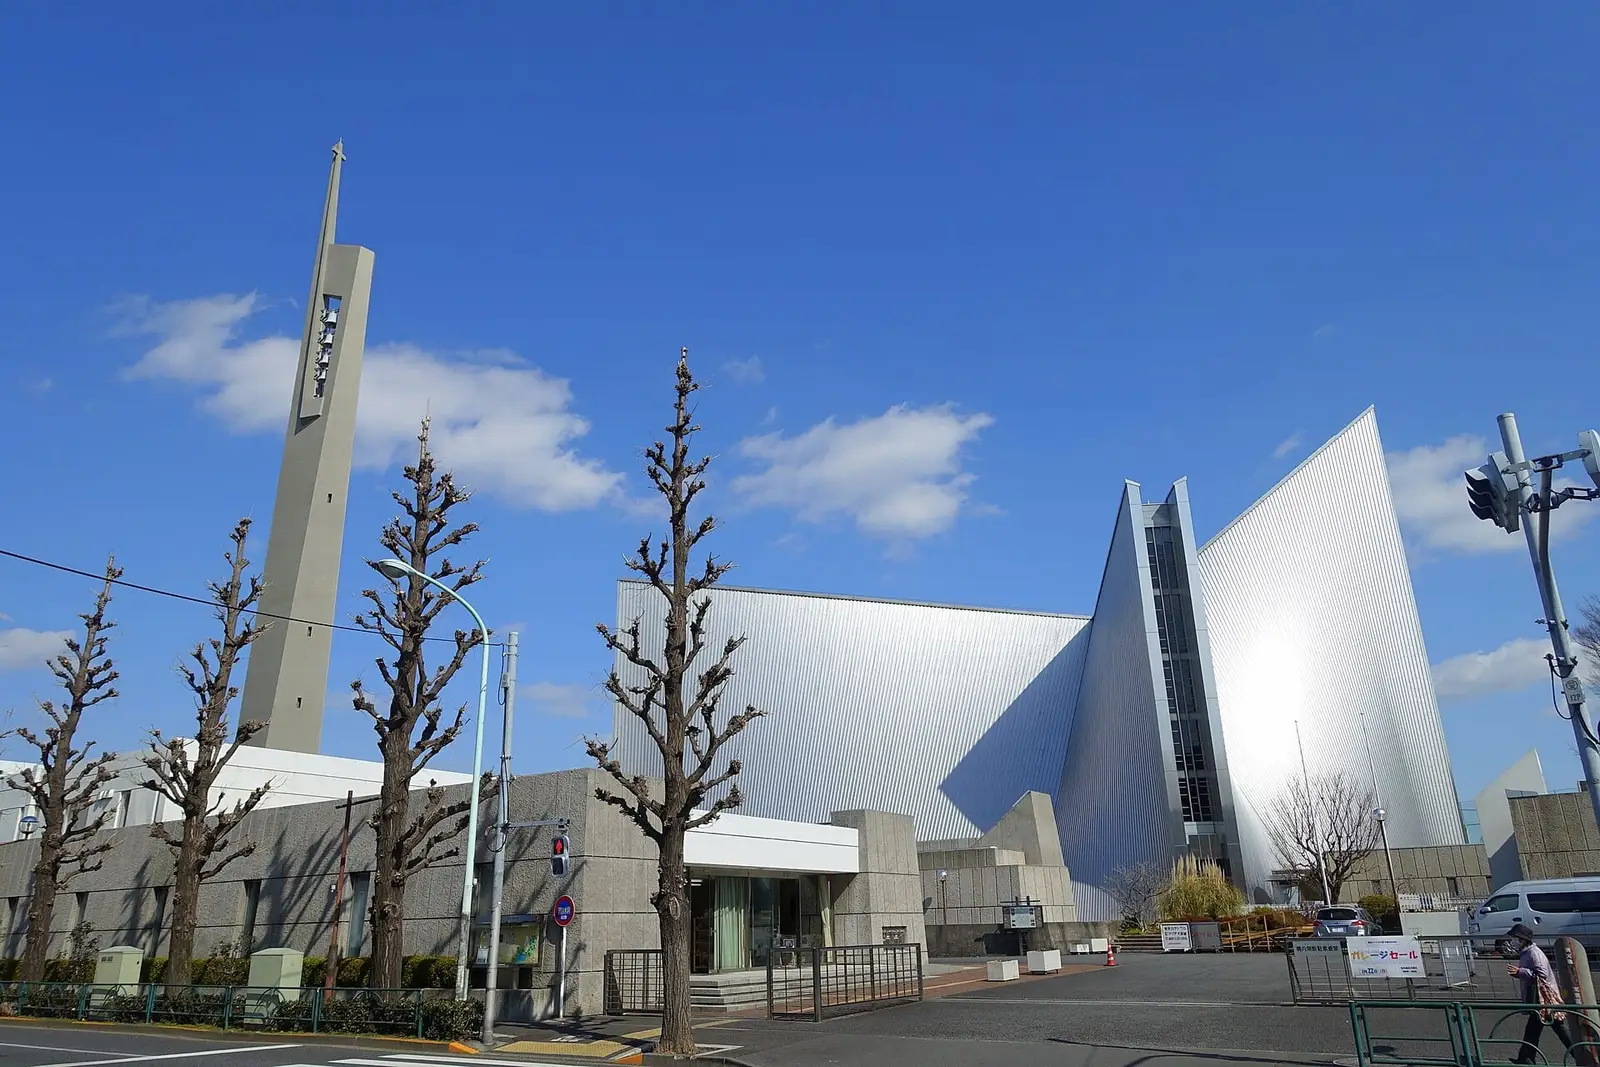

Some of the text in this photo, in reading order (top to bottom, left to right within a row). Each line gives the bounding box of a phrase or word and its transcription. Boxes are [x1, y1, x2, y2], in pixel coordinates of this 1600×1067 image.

[1351, 950, 1418, 959] ガレージセール
